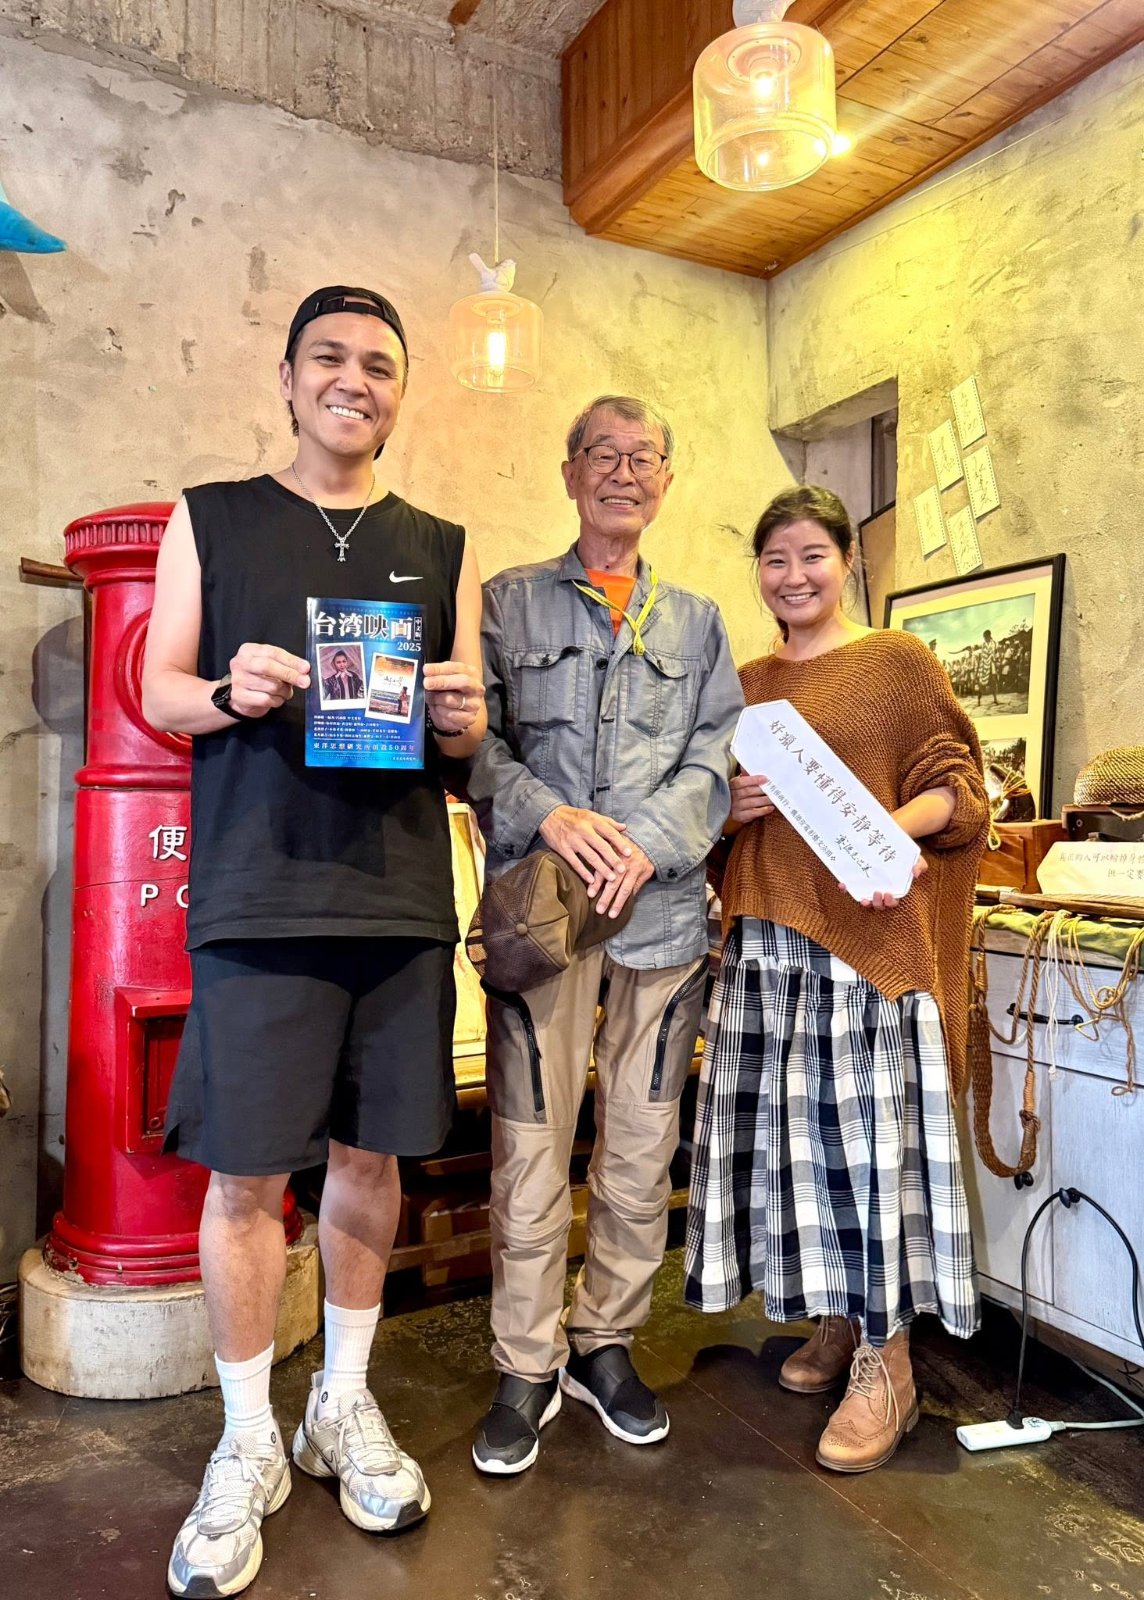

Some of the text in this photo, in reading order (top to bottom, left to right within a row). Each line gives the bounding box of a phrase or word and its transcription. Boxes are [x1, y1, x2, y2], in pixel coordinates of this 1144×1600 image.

[315, 611, 413, 640] 台湾映画
[397, 642, 421, 652] 2025
[769, 720, 897, 863] 好獵人要懂得安靜等待
[149, 824, 187, 861] 便
